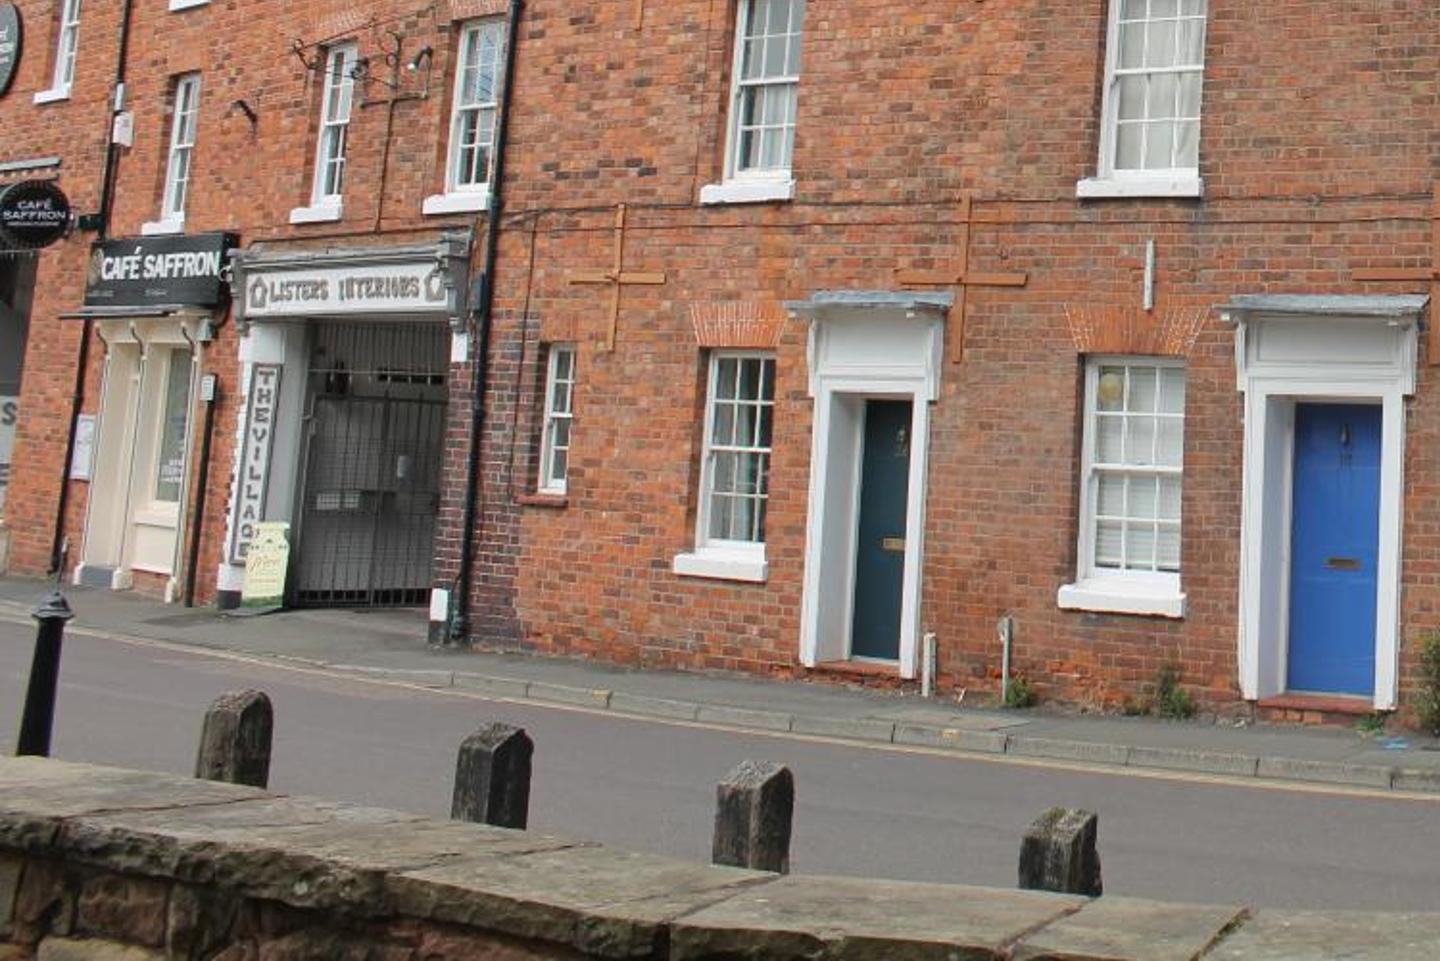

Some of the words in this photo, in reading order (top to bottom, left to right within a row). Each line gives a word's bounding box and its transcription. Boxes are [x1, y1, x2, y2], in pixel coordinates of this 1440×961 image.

[3, 210, 66, 219] SAFFRON
[102, 246, 142, 280] CAFÉ
[143, 251, 220, 278] SAFFRON
[270, 279, 329, 302] LISTERS
[338, 276, 419, 301] INTERIORS
[254, 370, 275, 423] THE
